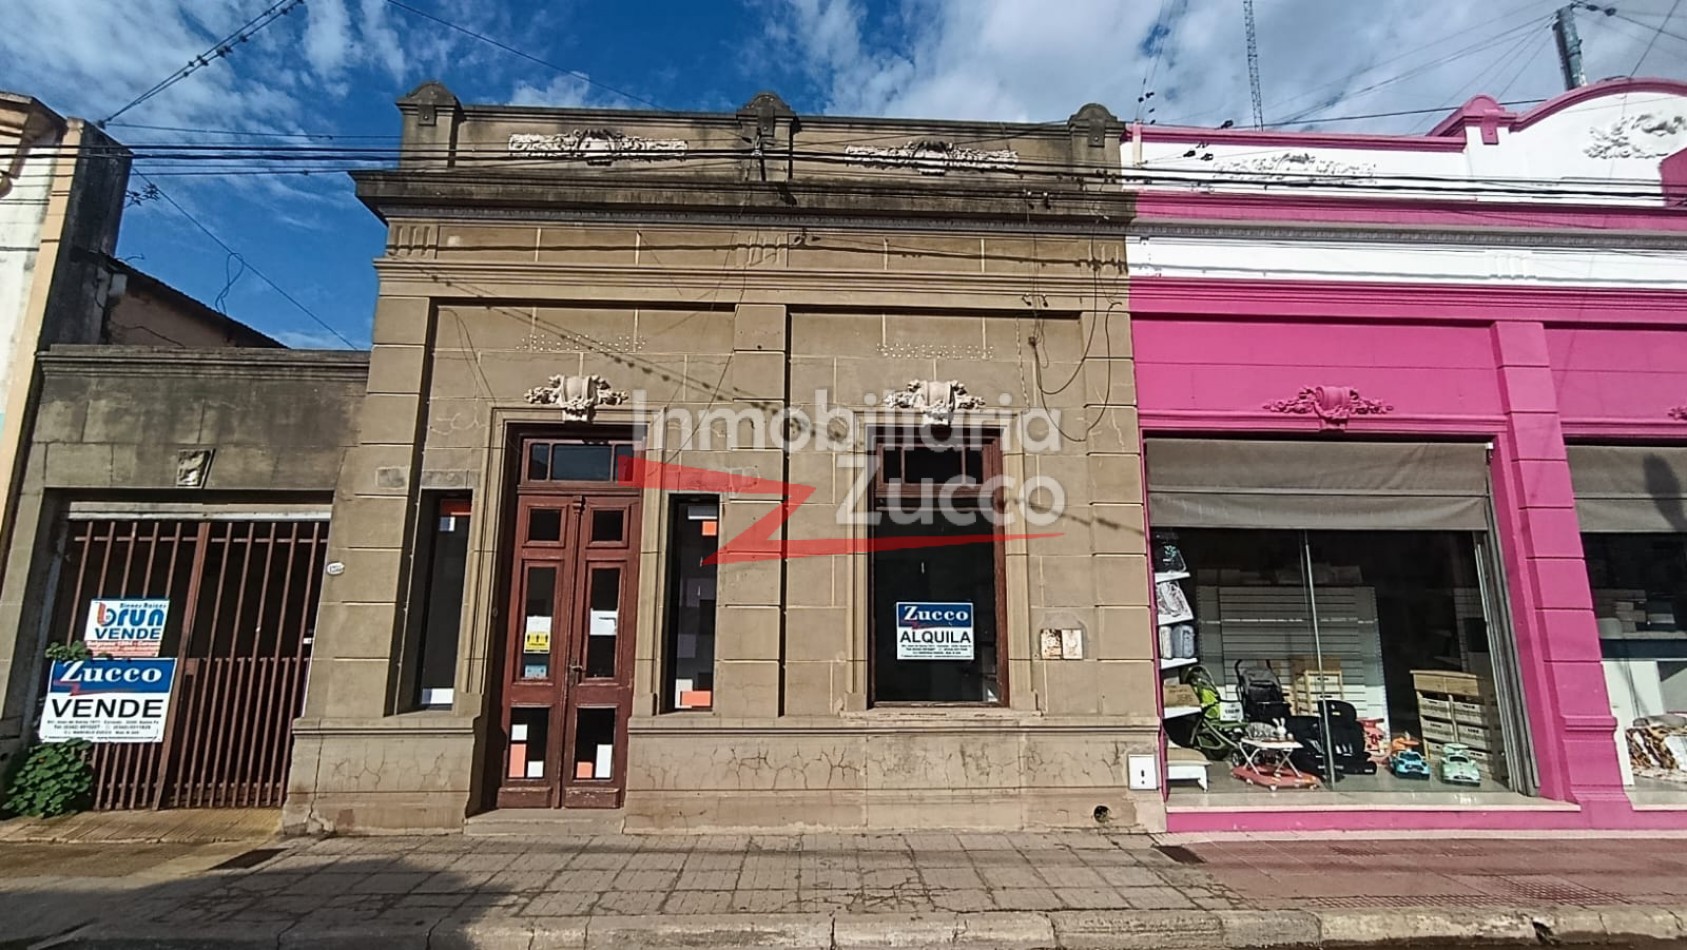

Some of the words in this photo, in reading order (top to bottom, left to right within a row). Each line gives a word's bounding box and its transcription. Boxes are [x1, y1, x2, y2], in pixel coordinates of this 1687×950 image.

[97, 602, 165, 627] brun
[904, 605, 969, 621] Zucco
[95, 628, 161, 640] VENDE
[900, 630, 971, 644] ALQUILA
[60, 660, 162, 682] Zucco
[52, 699, 164, 718] VENDE
